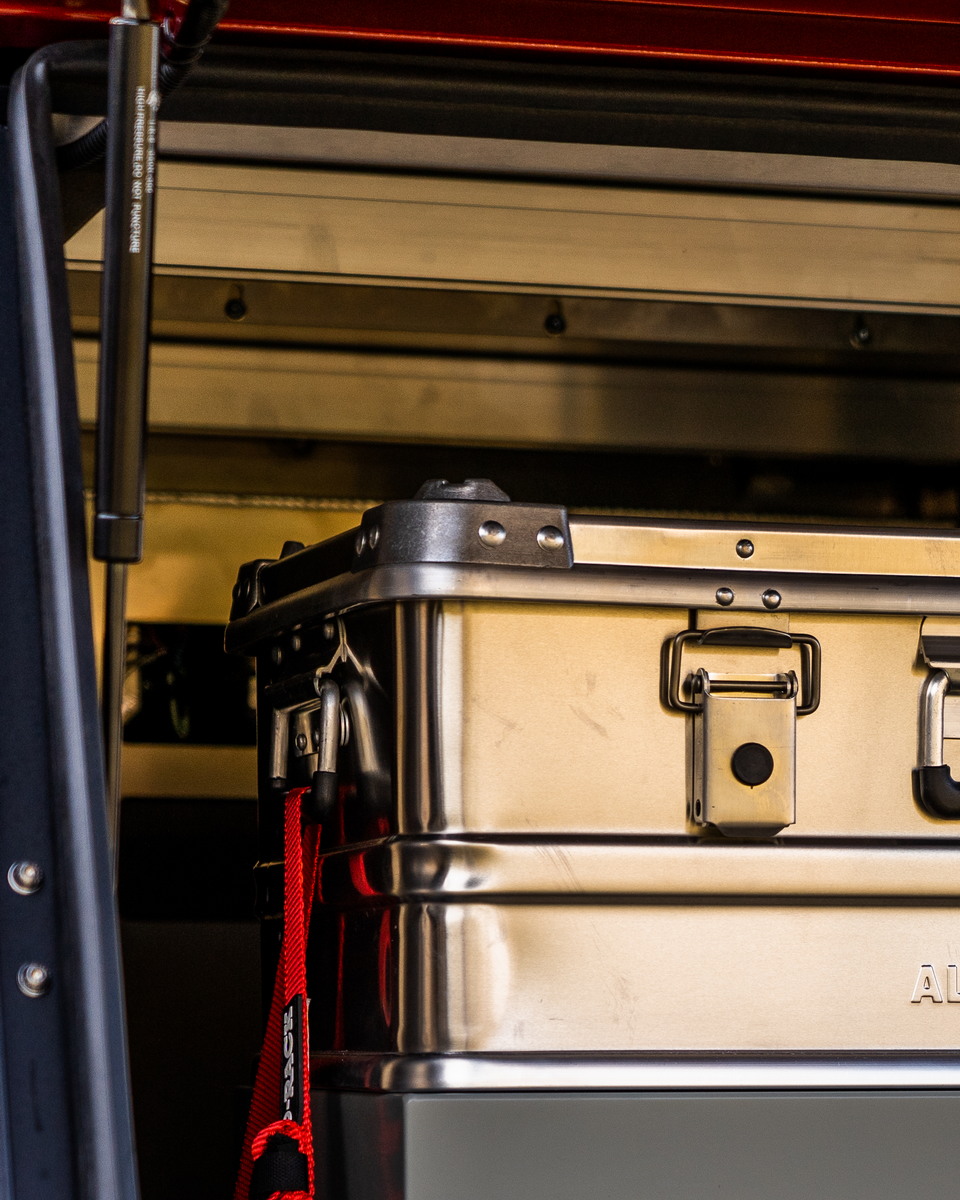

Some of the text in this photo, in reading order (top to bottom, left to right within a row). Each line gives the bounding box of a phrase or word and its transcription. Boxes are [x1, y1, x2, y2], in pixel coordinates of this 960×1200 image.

[135, 86, 146, 112] HIGH
[131, 180, 143, 201] NOT
[129, 202, 142, 254] PUNCTURE
